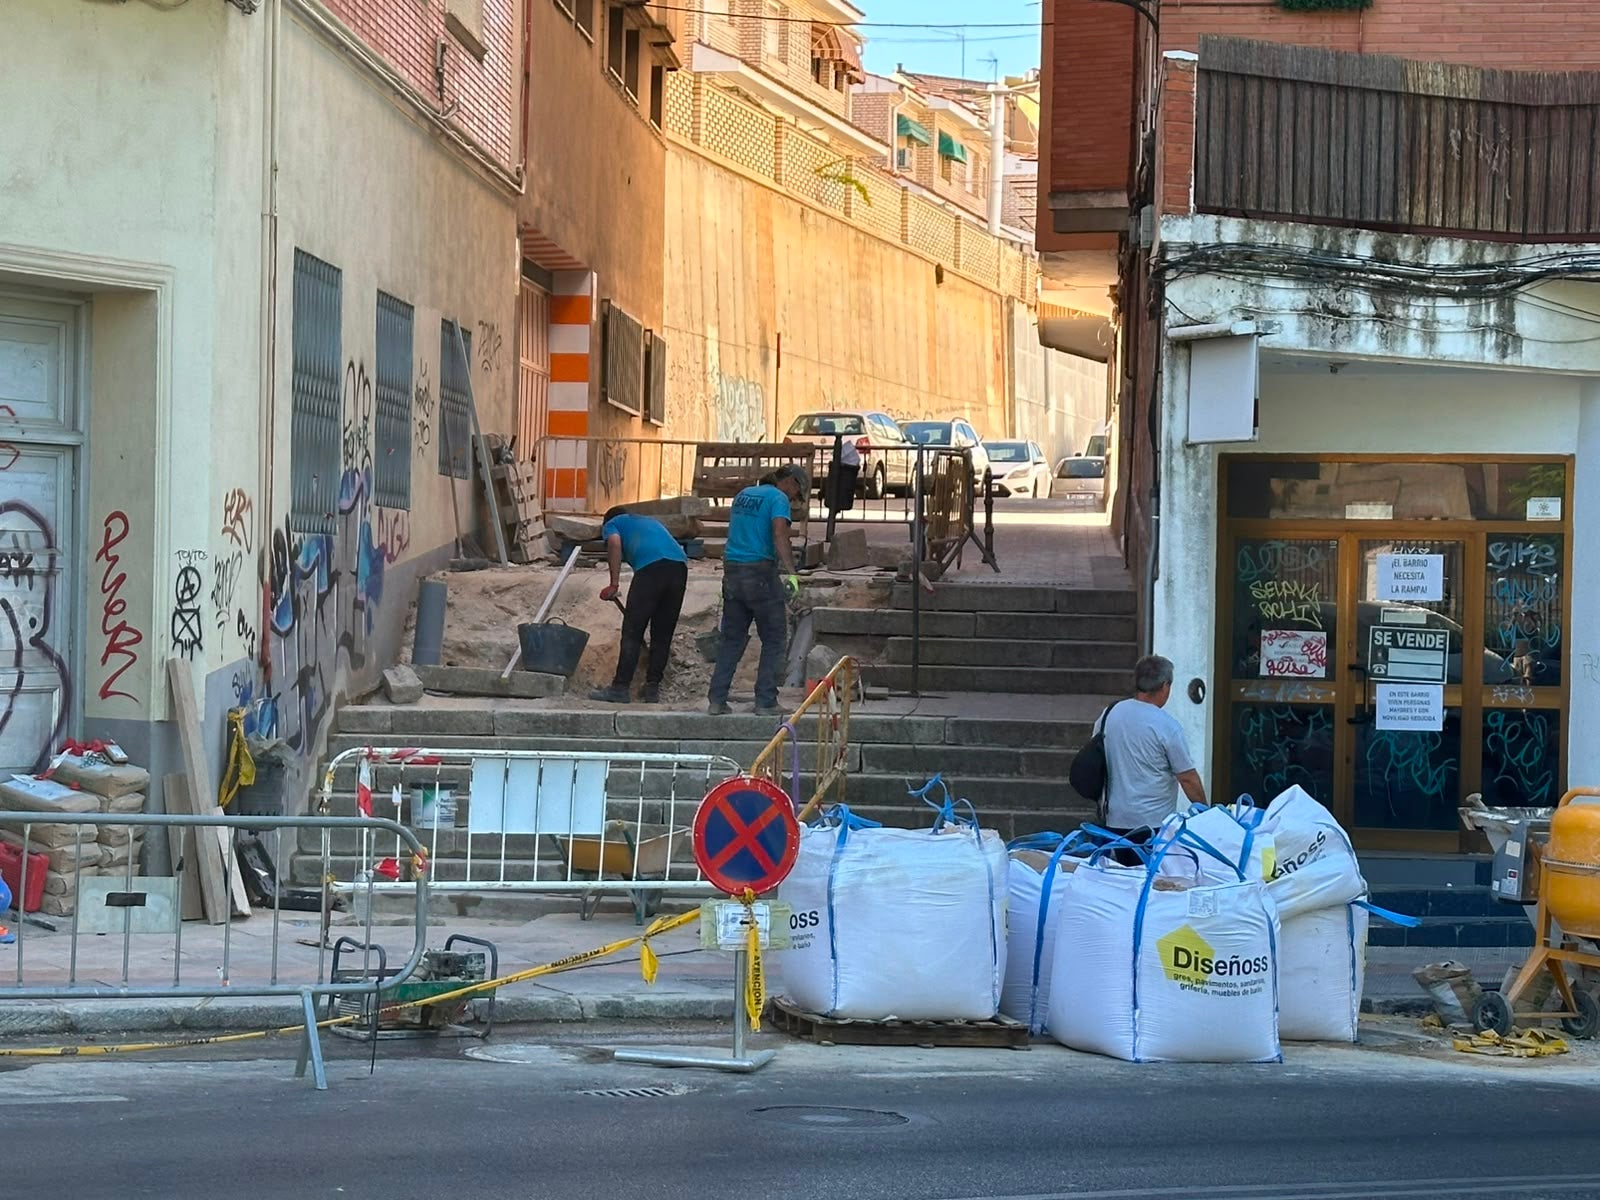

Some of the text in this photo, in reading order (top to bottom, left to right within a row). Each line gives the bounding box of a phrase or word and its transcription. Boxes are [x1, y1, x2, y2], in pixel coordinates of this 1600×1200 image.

[1403, 558, 1428, 568] BARRIO
[1394, 571, 1425, 580] NECESITA
[1391, 585, 1399, 593] LA
[1374, 631, 1446, 649] SE VENDE
[1173, 945, 1268, 976] Diseñoss
[1211, 988, 1241, 997] muebles
[1241, 988, 1249, 996] de
